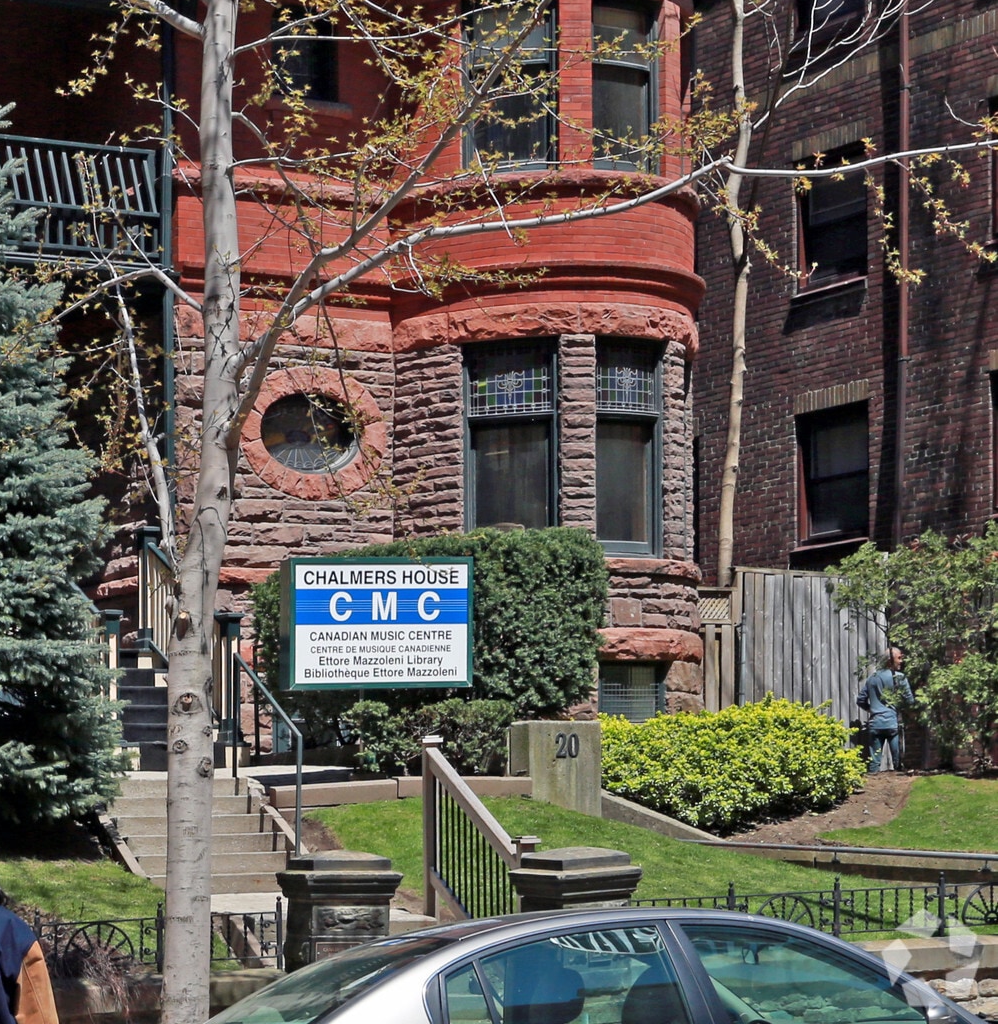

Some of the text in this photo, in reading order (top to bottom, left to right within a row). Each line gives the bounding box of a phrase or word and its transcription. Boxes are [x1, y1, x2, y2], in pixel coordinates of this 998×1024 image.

[303, 570, 459, 585] CHALMERS HOUSE
[309, 630, 452, 642] CANADIAN MUSIC CENTRE
[310, 644, 452, 654] CENTRE DE MUSIQUE CANADIENNE
[318, 655, 444, 667] Ettore Mazzoleni Library
[304, 666, 458, 680] Bibliothèque Ettore Mazzoleni
[555, 732, 580, 759] 20
